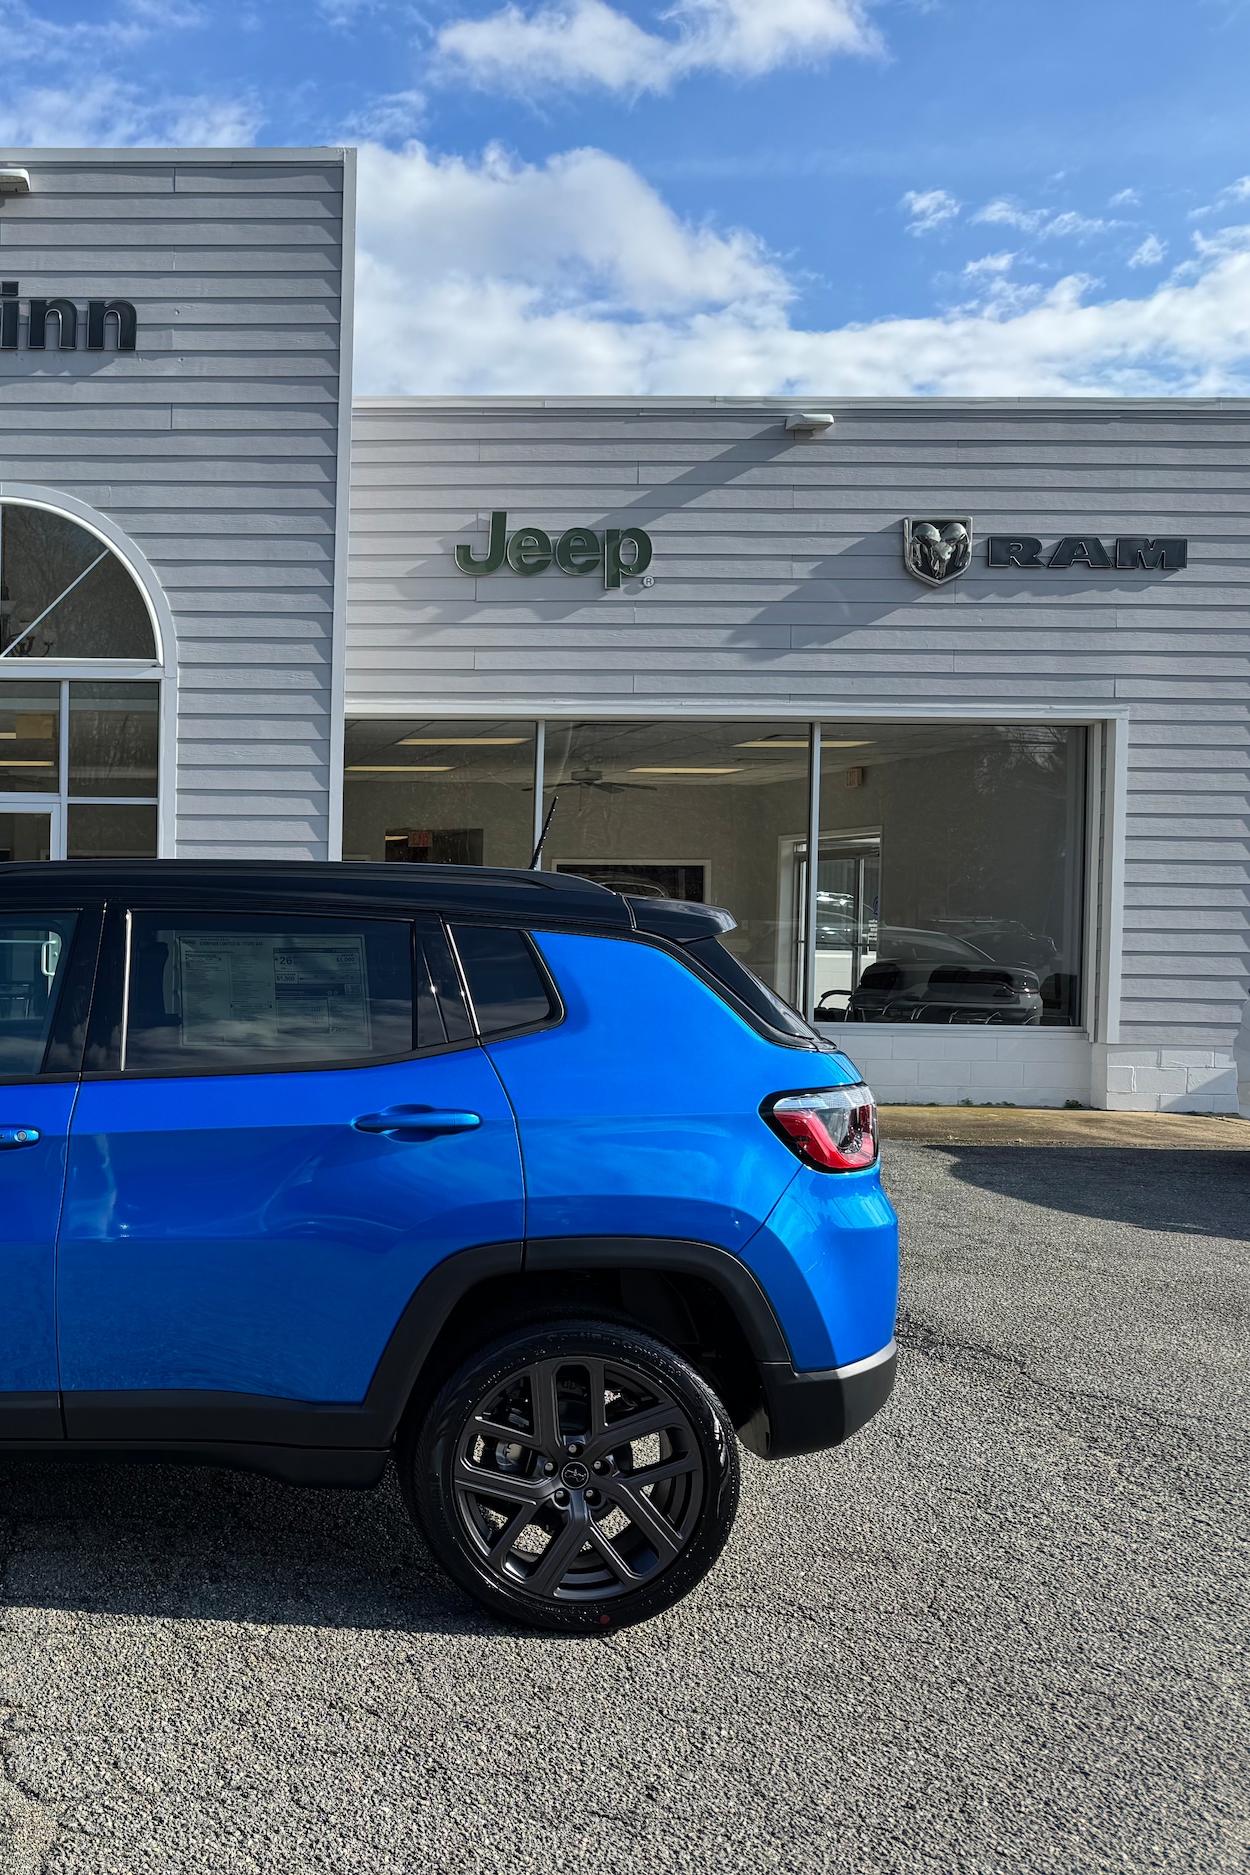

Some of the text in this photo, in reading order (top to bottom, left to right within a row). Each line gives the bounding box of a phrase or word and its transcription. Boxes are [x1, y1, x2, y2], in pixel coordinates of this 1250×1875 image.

[454, 511, 654, 590] Jeep
[987, 536, 1188, 569] RAM
[279, 956, 292, 965] 26
